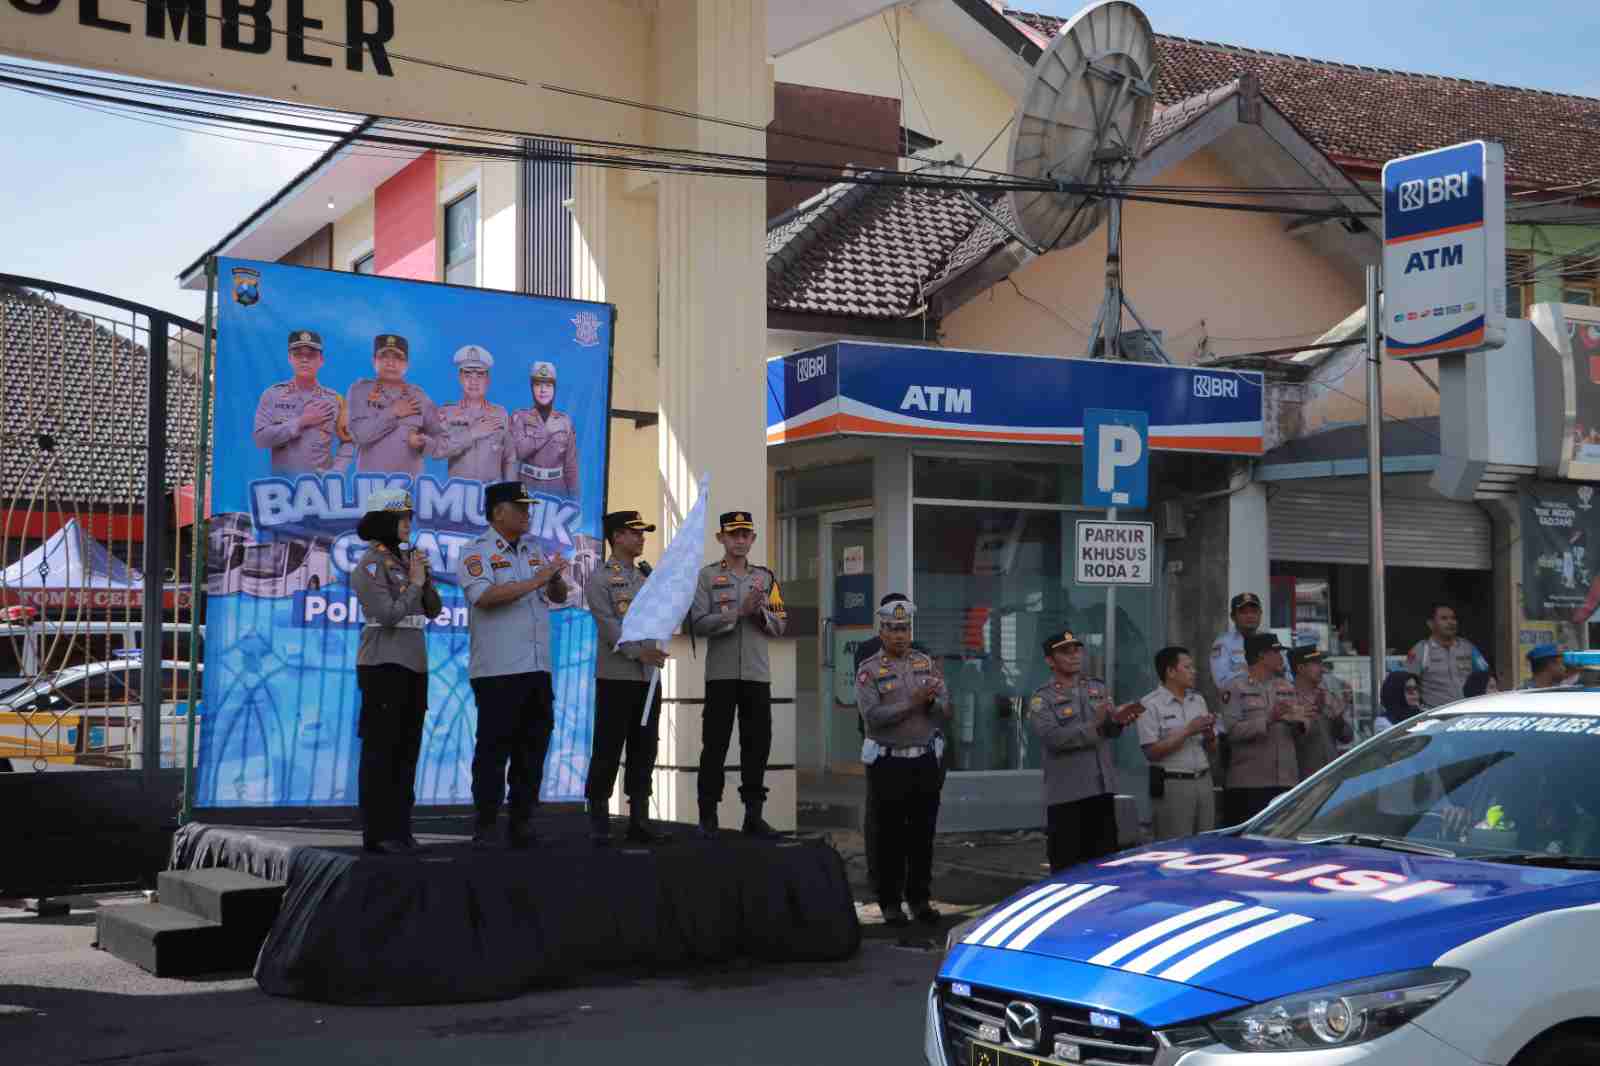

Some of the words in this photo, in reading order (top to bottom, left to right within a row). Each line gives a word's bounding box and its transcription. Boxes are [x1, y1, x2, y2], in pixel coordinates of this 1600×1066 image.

[1427, 171, 1469, 204] BRI
[1404, 244, 1464, 274] ATM
[808, 354, 827, 378] BRI
[900, 385, 972, 413] ATM
[1211, 378, 1238, 398] BRI
[1097, 424, 1142, 492] P
[418, 476, 580, 548] MUIK
[1084, 527, 1145, 543] PARKIR
[1082, 547, 1147, 562] KHUSUS
[1084, 564, 1128, 578] RODA
[1132, 565, 1141, 577] 2
[1097, 850, 1456, 903] POLISI
